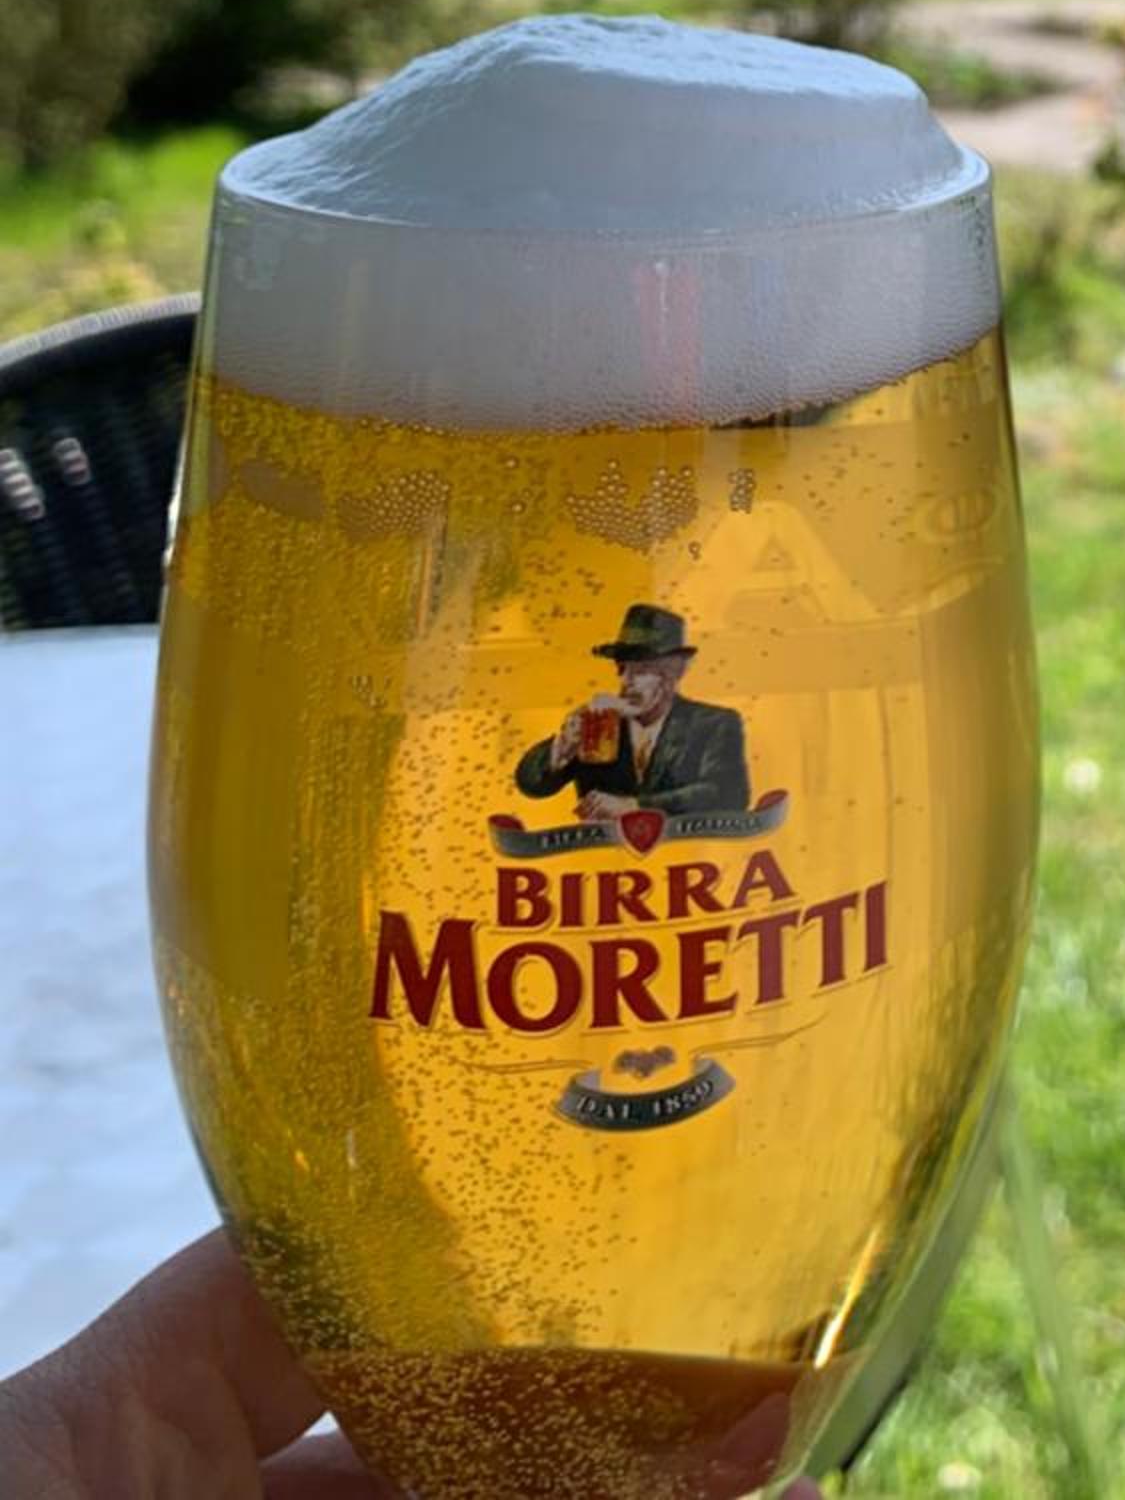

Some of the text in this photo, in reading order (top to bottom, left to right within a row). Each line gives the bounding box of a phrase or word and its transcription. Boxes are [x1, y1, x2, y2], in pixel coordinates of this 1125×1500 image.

[495, 849, 795, 929] BIRRA
[367, 880, 889, 1033] MORETTI
[575, 1094, 640, 1121] DAL
